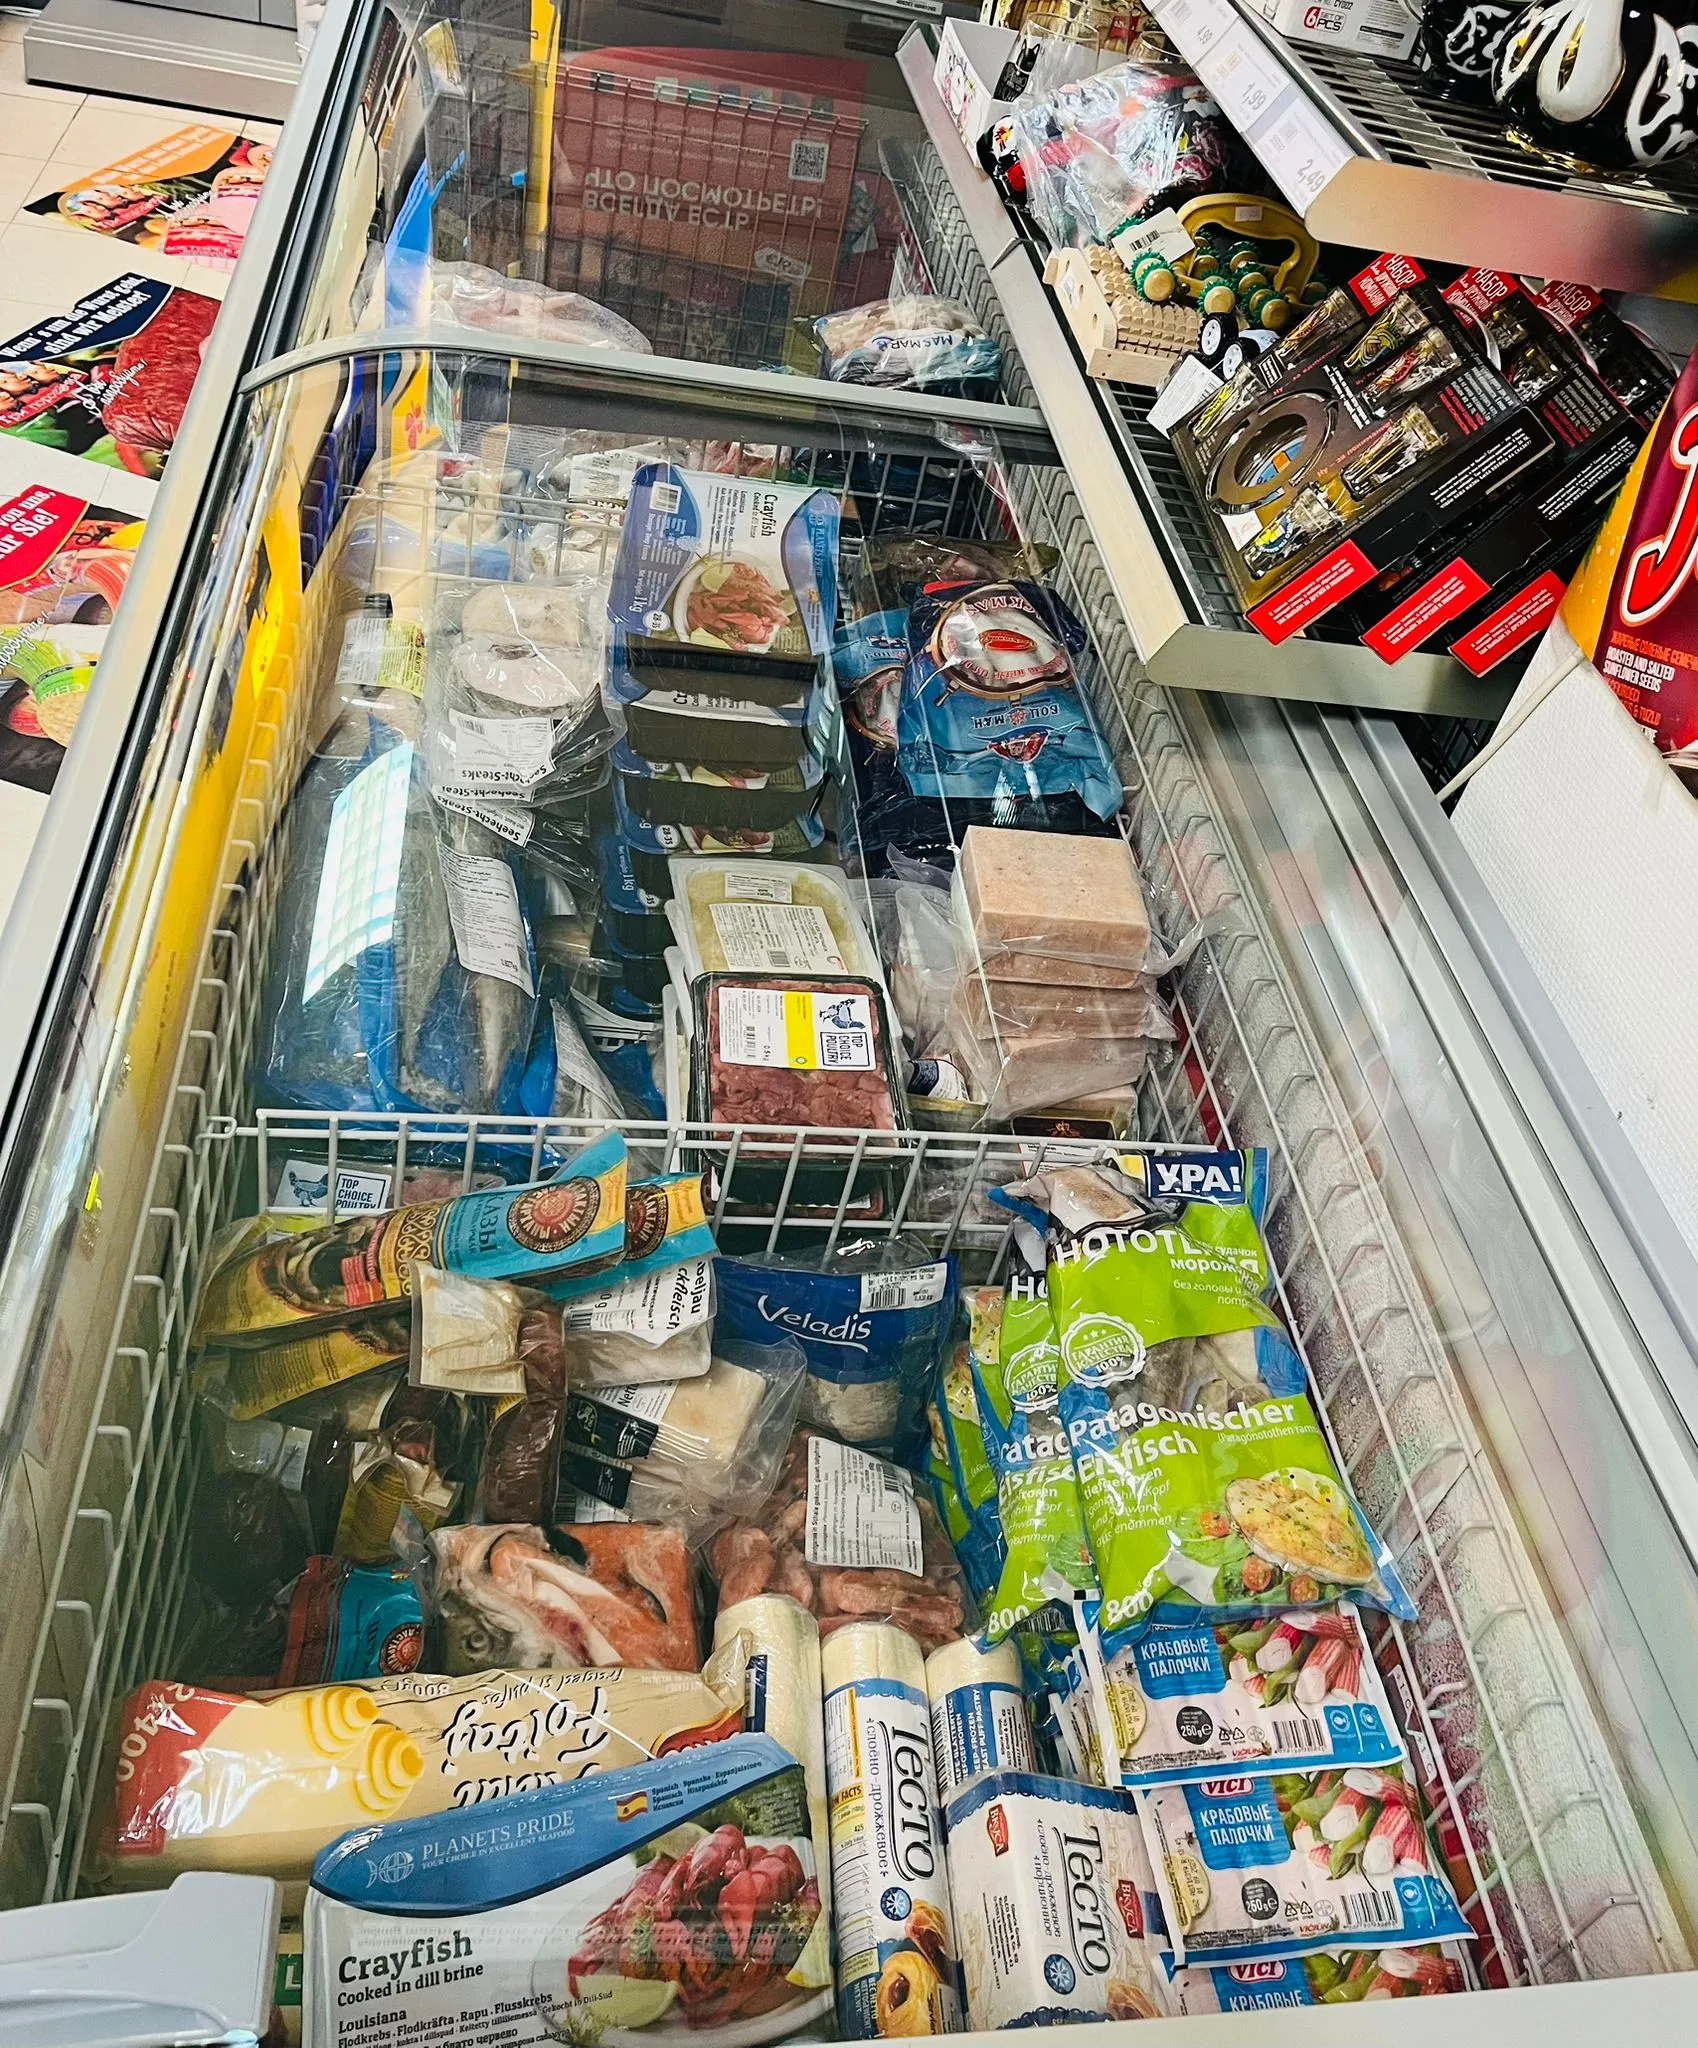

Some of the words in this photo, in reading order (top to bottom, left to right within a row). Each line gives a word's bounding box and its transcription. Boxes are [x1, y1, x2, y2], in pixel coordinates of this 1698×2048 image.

[1317, 18, 1343, 31] PCS
[1241, 83, 1268, 111] 1,99
[1298, 159, 1327, 193] 2,49
[1383, 253, 1417, 289] НАБОР
[1471, 266, 1508, 301] НАБОР
[1553, 281, 1592, 315] НАБОР
[20, 505, 60, 544] Sie!
[761, 493, 779, 537] Crayfish
[1603, 660, 1640, 686] SUNFLOWER
[1638, 675, 1662, 693] SEEDS
[1605, 646, 1636, 668] ROASTED
[1634, 655, 1648, 673] AND
[1646, 660, 1676, 681] SALTED
[825, 1034, 840, 1065] POULTRY
[838, 1034, 853, 1062] CHOICE
[851, 1034, 864, 1049] TOP
[341, 1177, 360, 1190] TOP
[1154, 1162, 1243, 1194] УРА!
[337, 1189, 374, 1202] CHOICE
[757, 1294, 873, 1340] Veladis
[1096, 1356, 1126, 1375] 100%
[1069, 1399, 1297, 1445] Patagonischer
[1077, 1429, 1200, 1484] Eisfisch
[987, 1605, 1032, 1635] 800
[1104, 1590, 1155, 1626] 800
[1140, 1637, 1210, 1661] КРАБОВЫЕ
[557, 1667, 625, 1691] fraged
[1148, 1657, 1212, 1679] ПАЛОЧКИ
[481, 1681, 536, 1710] pufos
[841, 1784, 863, 1803] FACTS
[890, 1723, 936, 1881] Тесто
[1199, 1802, 1272, 1829] КРАБОВЫЕ
[422, 1825, 511, 1860] PLANETS
[514, 1809, 576, 1839] PRIDE
[445, 1850, 477, 1867] CHOICE
[489, 1838, 536, 1857] EXCELLENT
[537, 1827, 576, 1846] SEAFOOD
[1209, 1823, 1275, 1847] ПАЛОЧКИ
[1033, 1862, 1053, 1937] порционное
[1062, 1825, 1111, 1975] Тесто
[338, 1929, 473, 1984] Crayfish
[336, 1978, 394, 2008] Cooked
[395, 1972, 412, 1994] in
[413, 1965, 441, 1989] dill
[442, 1961, 485, 1988] brine
[541, 1998, 573, 2016] Gekocht
[1228, 1988, 1303, 2014] КРАБОВЫЕ
[337, 2025, 392, 2048] Flodkrebs
[396, 2012, 455, 2038] Flodkräfta
[459, 2004, 490, 2028] Rapu
[493, 1990, 554, 2016] Flusskrebs
[337, 2007, 408, 2034] Louisiana
